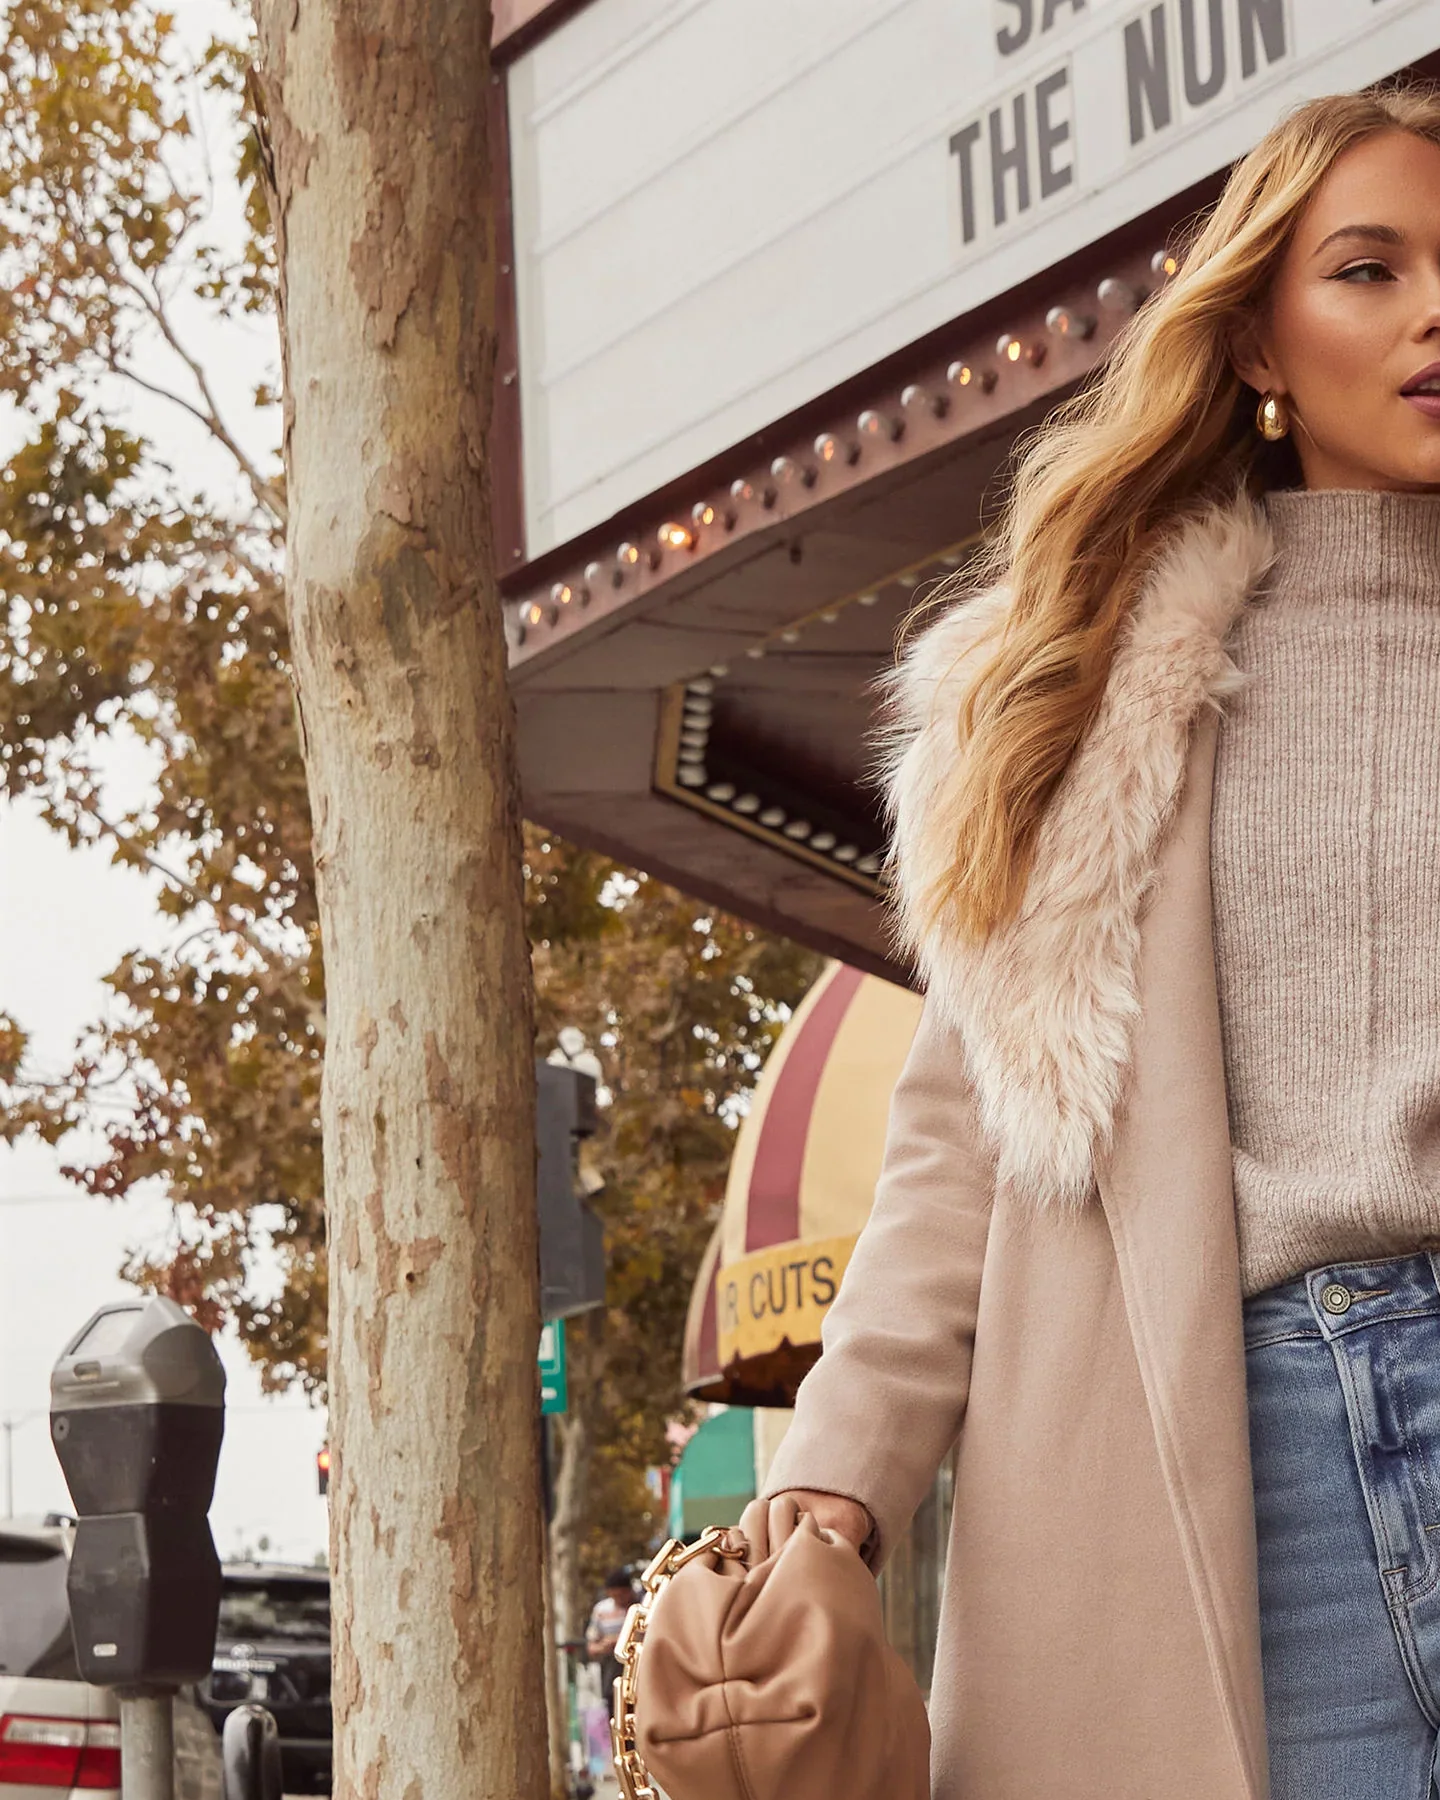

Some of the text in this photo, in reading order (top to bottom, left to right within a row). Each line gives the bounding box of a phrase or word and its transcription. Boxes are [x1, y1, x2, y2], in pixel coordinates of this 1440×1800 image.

[949, 0, 1286, 245] THE NUN
[750, 1256, 836, 1320] CUTS
